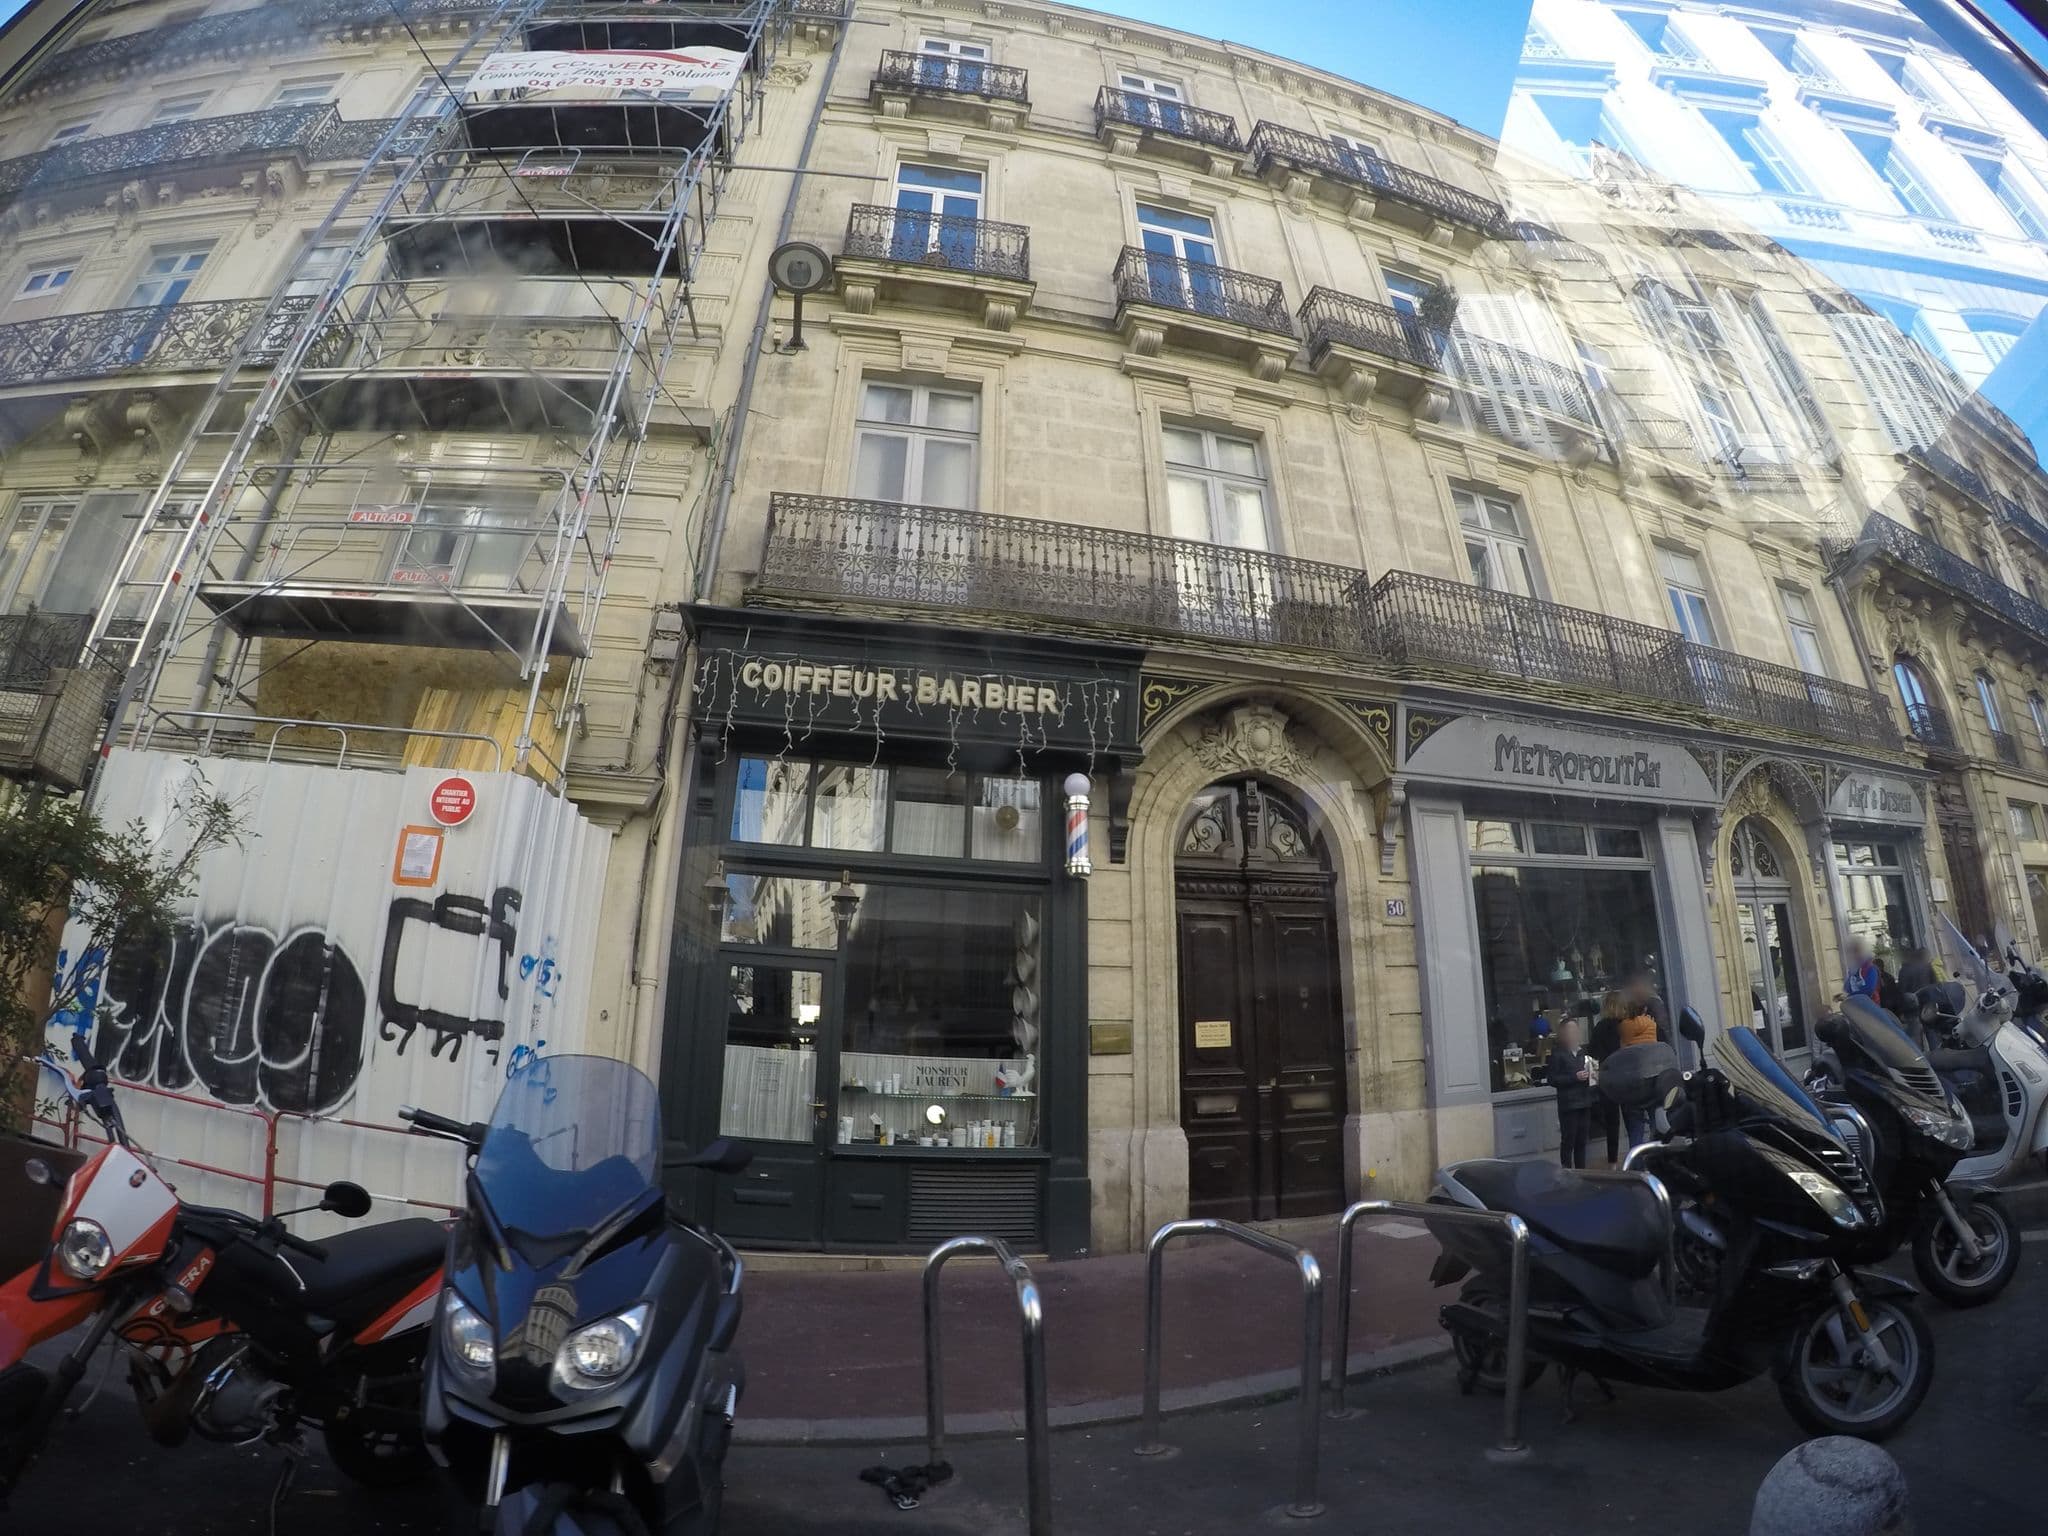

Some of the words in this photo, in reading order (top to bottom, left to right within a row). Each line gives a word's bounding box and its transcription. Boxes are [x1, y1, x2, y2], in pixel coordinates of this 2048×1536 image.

[478, 69, 561, 81] Couverture
[528, 79, 551, 88] 04
[556, 77, 578, 88] 67
[583, 77, 607, 86] 04
[612, 77, 636, 86] 33
[640, 78, 665, 87] 52
[359, 512, 408, 522] ALTRAD
[461, 798, 471, 806] AU
[1387, 900, 1404, 916] 30
[915, 1065, 968, 1076] MONSIEUR
[915, 1075, 968, 1088] LAURENT
[149, 1257, 211, 1316] GERA
